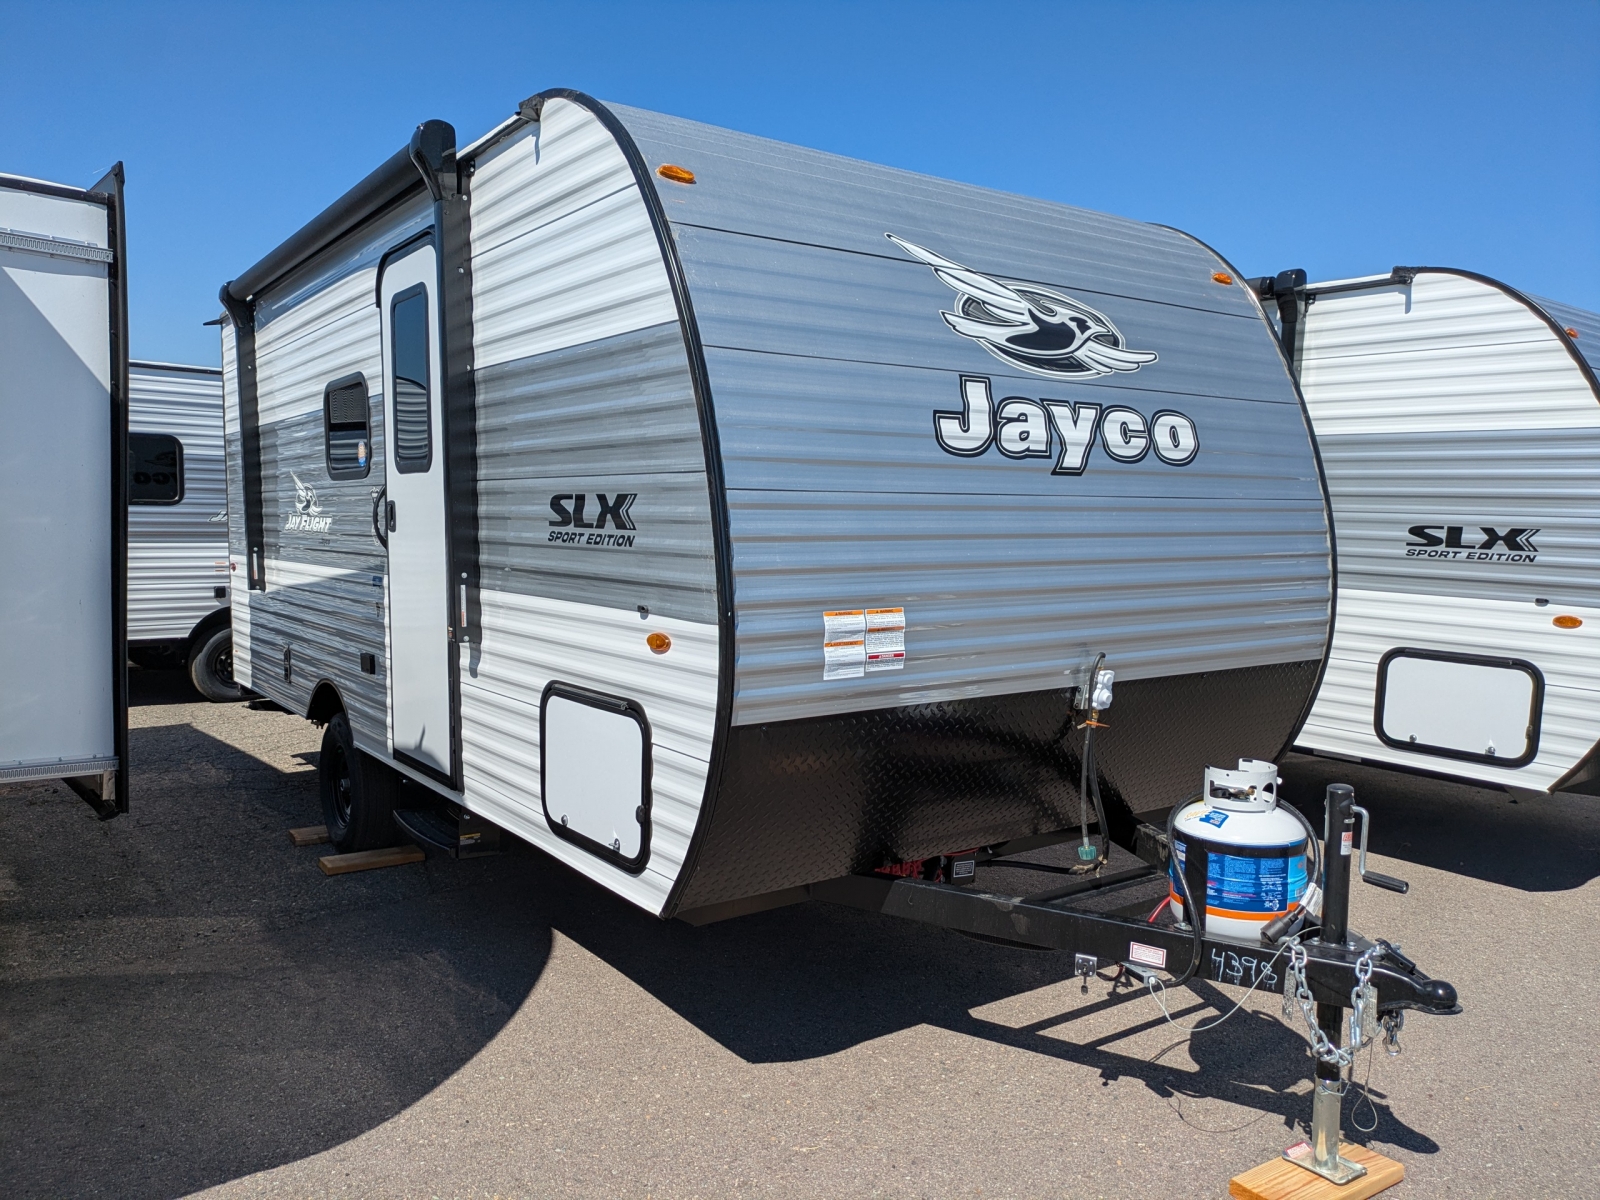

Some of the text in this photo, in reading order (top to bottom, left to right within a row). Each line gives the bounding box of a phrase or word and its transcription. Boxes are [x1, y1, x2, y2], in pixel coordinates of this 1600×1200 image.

[933, 374, 1200, 476] Jayco
[285, 512, 333, 533] JAY FLIGHT
[549, 493, 638, 531] SLX
[548, 531, 635, 548] SPORT EDITION
[1406, 525, 1541, 552] SLX
[1405, 549, 1537, 563] SPORT EDITION
[1211, 948, 1278, 985] 4398
